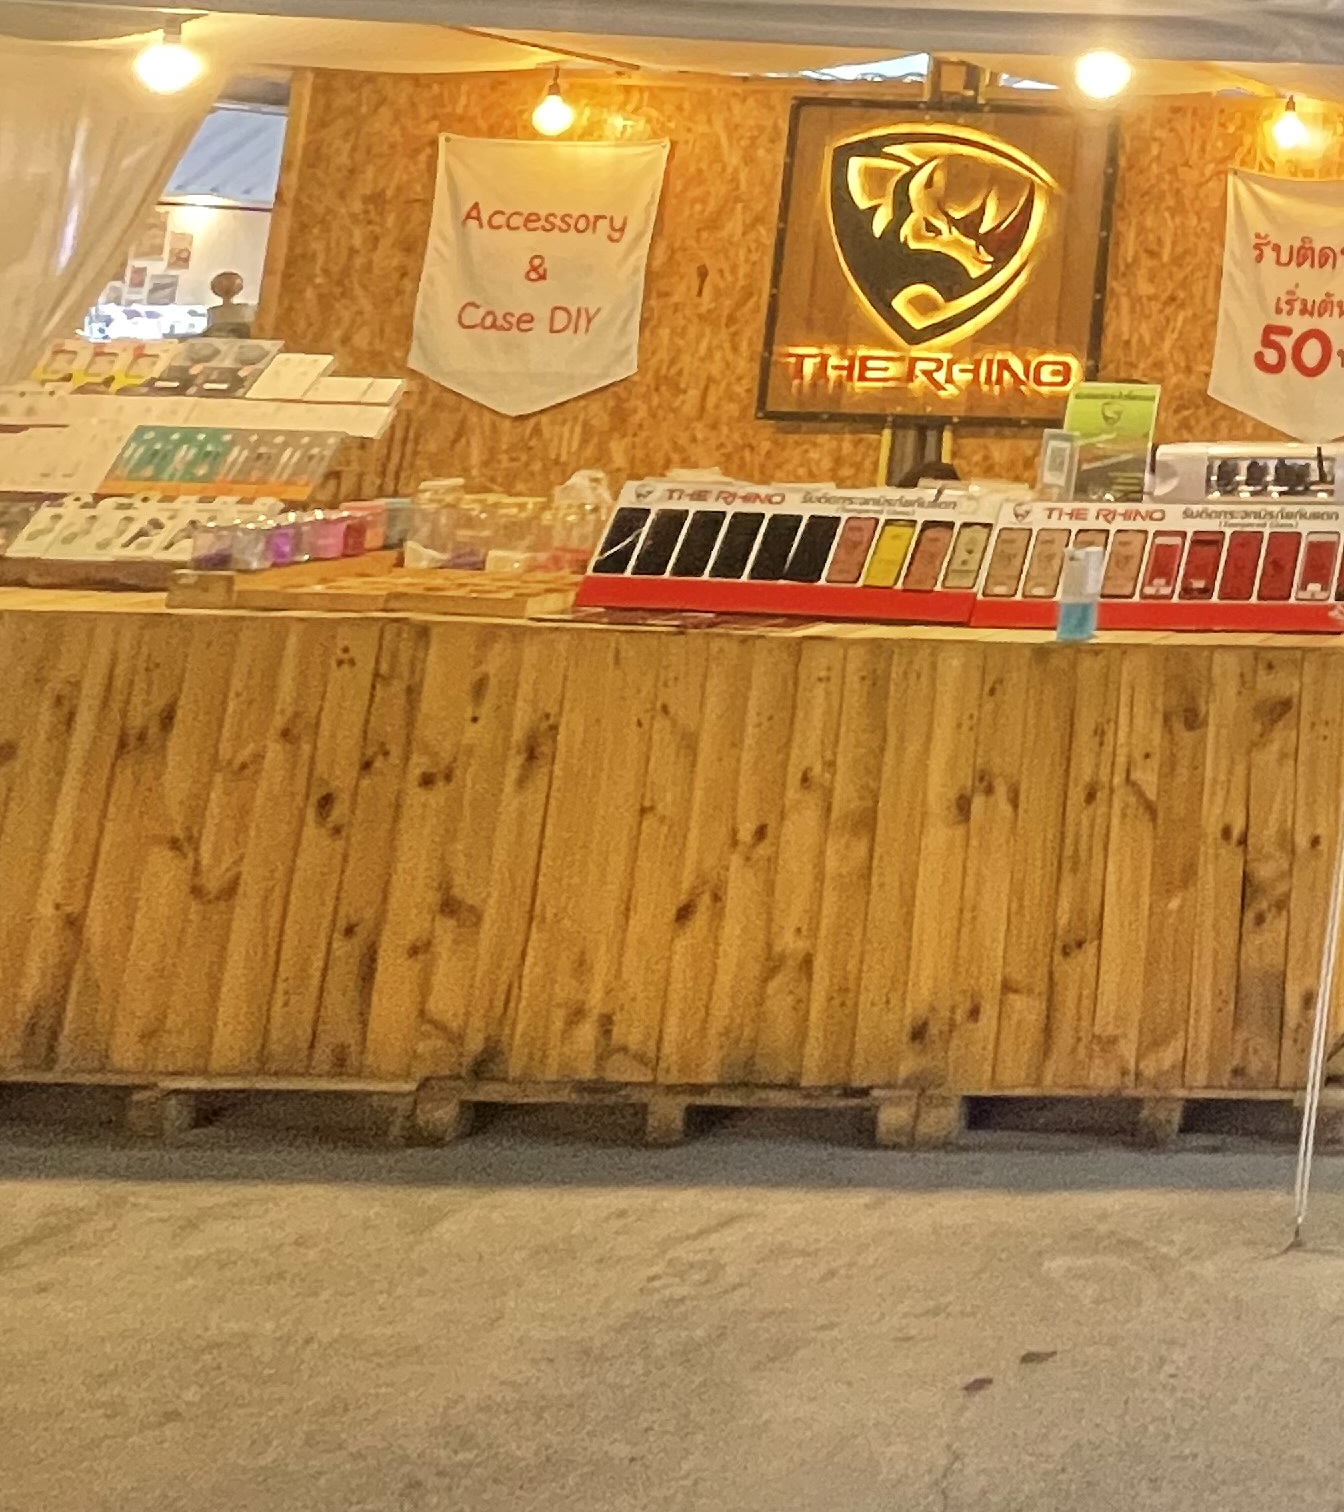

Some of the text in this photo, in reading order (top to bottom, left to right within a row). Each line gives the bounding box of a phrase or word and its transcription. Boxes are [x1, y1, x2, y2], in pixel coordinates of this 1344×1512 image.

[461, 201, 629, 243] Accessory
[523, 254, 548, 282] &
[457, 301, 602, 335] Case DIY
[1253, 323, 1333, 378] 50
[784, 350, 1073, 393] THE RHINO
[664, 488, 787, 506] THE RHINO
[1042, 506, 1167, 524] THE RHINO
